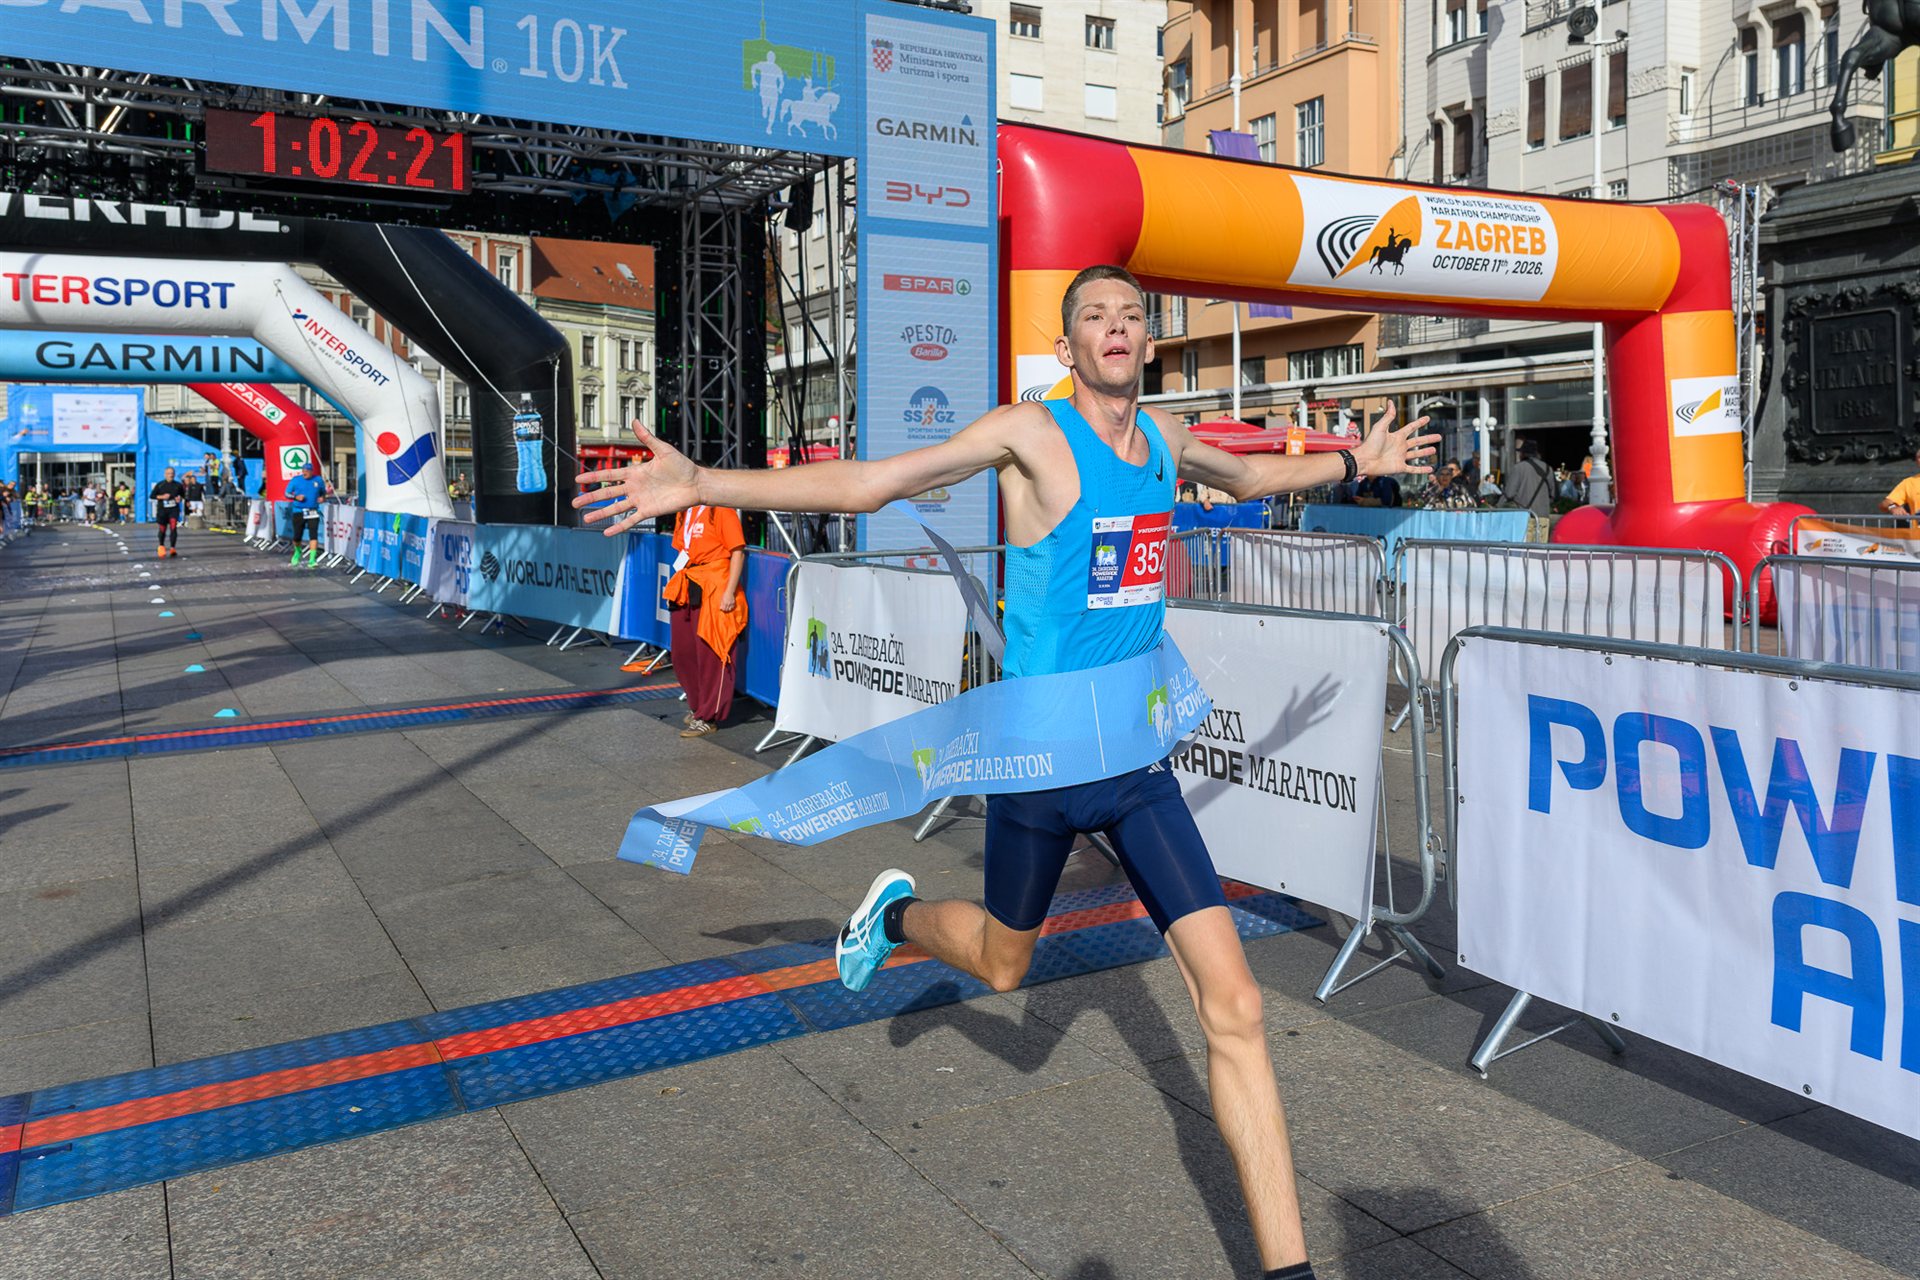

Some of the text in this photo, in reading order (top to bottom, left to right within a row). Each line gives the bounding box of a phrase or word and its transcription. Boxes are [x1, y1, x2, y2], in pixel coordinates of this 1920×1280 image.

[0, 0, 629, 89] RMIN 10K
[899, 44, 983, 63] REPUBLIKA HRVATSKA
[899, 53, 957, 70] Ministarstvo
[899, 66, 934, 78] turizma
[942, 73, 970, 83] sporta
[251, 112, 465, 191] 1:02:21
[886, 181, 970, 207] BYD
[1425, 196, 1536, 213] WORLD MASTERS ATHLETICS
[1431, 206, 1541, 223] MARATHON CHAMPIONSHIP
[1435, 219, 1546, 256] ZAGREB
[1433, 254, 1490, 272] OCTOBER
[2, 273, 235, 310] TERSPORT
[900, 277, 953, 291] SPAR
[904, 324, 953, 345] PESTO
[35, 341, 265, 373] GARMIN
[303, 318, 390, 387] INTERSPORT
[227, 383, 269, 412] PAR
[504, 559, 554, 588] WORLD
[555, 564, 619, 598] ATHLETIC
[831, 631, 905, 666] 34. ZABAČKI
[905, 673, 955, 705] MARATON
[1169, 672, 1186, 699] 34.
[974, 752, 1053, 781] MARATON
[1248, 754, 1357, 813] MARATON
[767, 780, 854, 830] 34. ZAGREBAČKI
[779, 791, 890, 843] POWERADE MARATON
[656, 816, 681, 848] ZAGR
